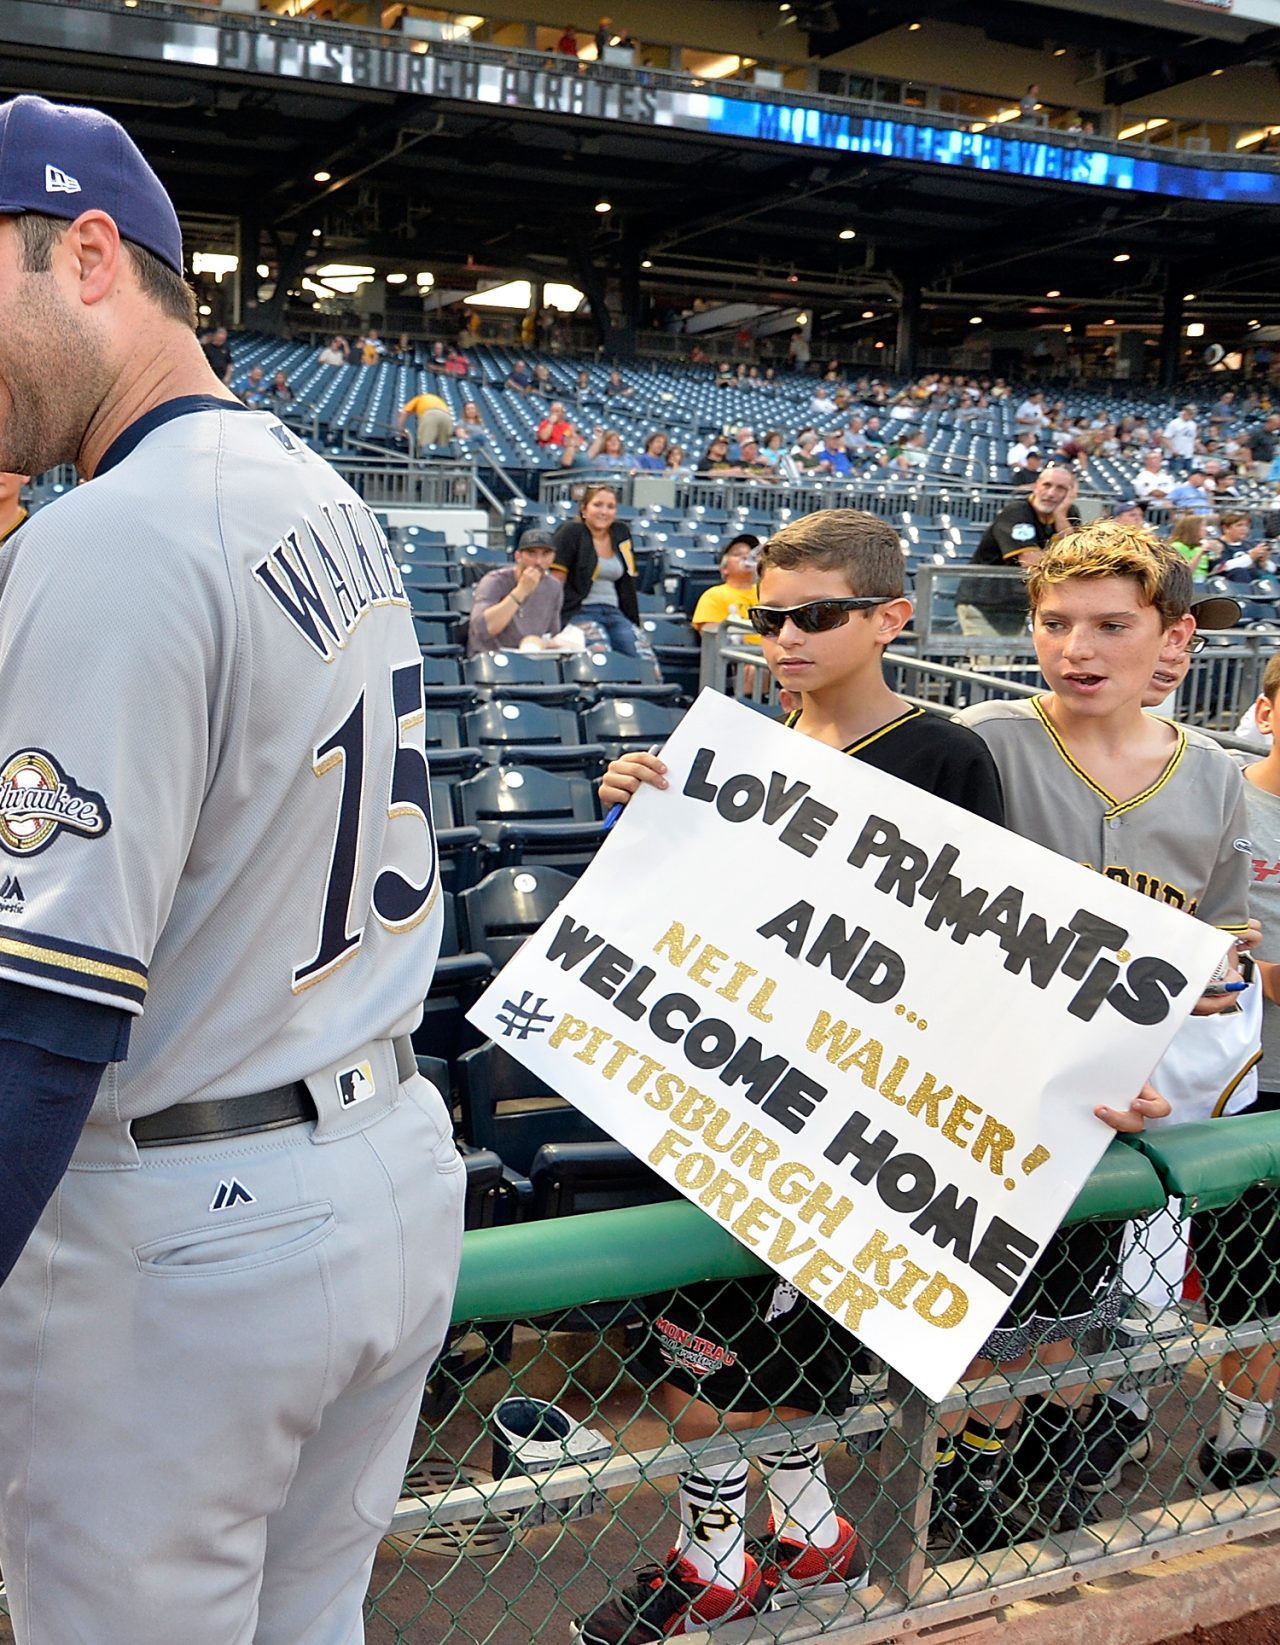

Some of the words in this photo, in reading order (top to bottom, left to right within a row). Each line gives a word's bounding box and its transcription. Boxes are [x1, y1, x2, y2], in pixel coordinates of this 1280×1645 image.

[252, 501, 411, 664] WALKE
[291, 656, 442, 994] 15
[682, 747, 839, 858] LOVE
[652, 920, 778, 1024] NEIL
[806, 1009, 1052, 1192] WALKER!
[756, 899, 929, 1031] AND...
[495, 990, 855, 1239] #PITTSBURGH
[851, 1228, 970, 1329] KID
[545, 914, 828, 1135] WELCOME
[822, 1110, 1040, 1298] HOME
[647, 1128, 880, 1332] FOREVER
